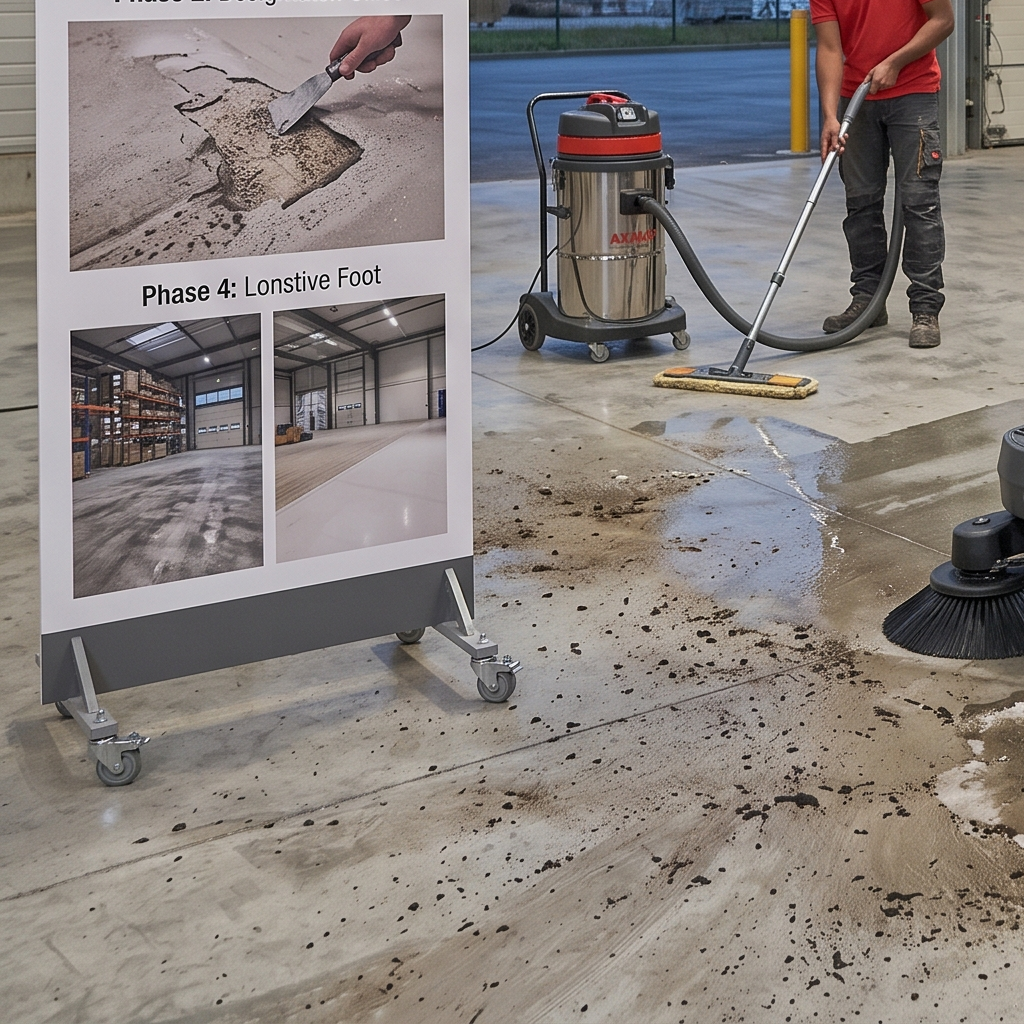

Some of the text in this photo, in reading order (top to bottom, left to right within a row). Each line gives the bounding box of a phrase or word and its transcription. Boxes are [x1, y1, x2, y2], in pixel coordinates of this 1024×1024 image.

[142, 264, 382, 307] Phase 4: Lonstive Foot
